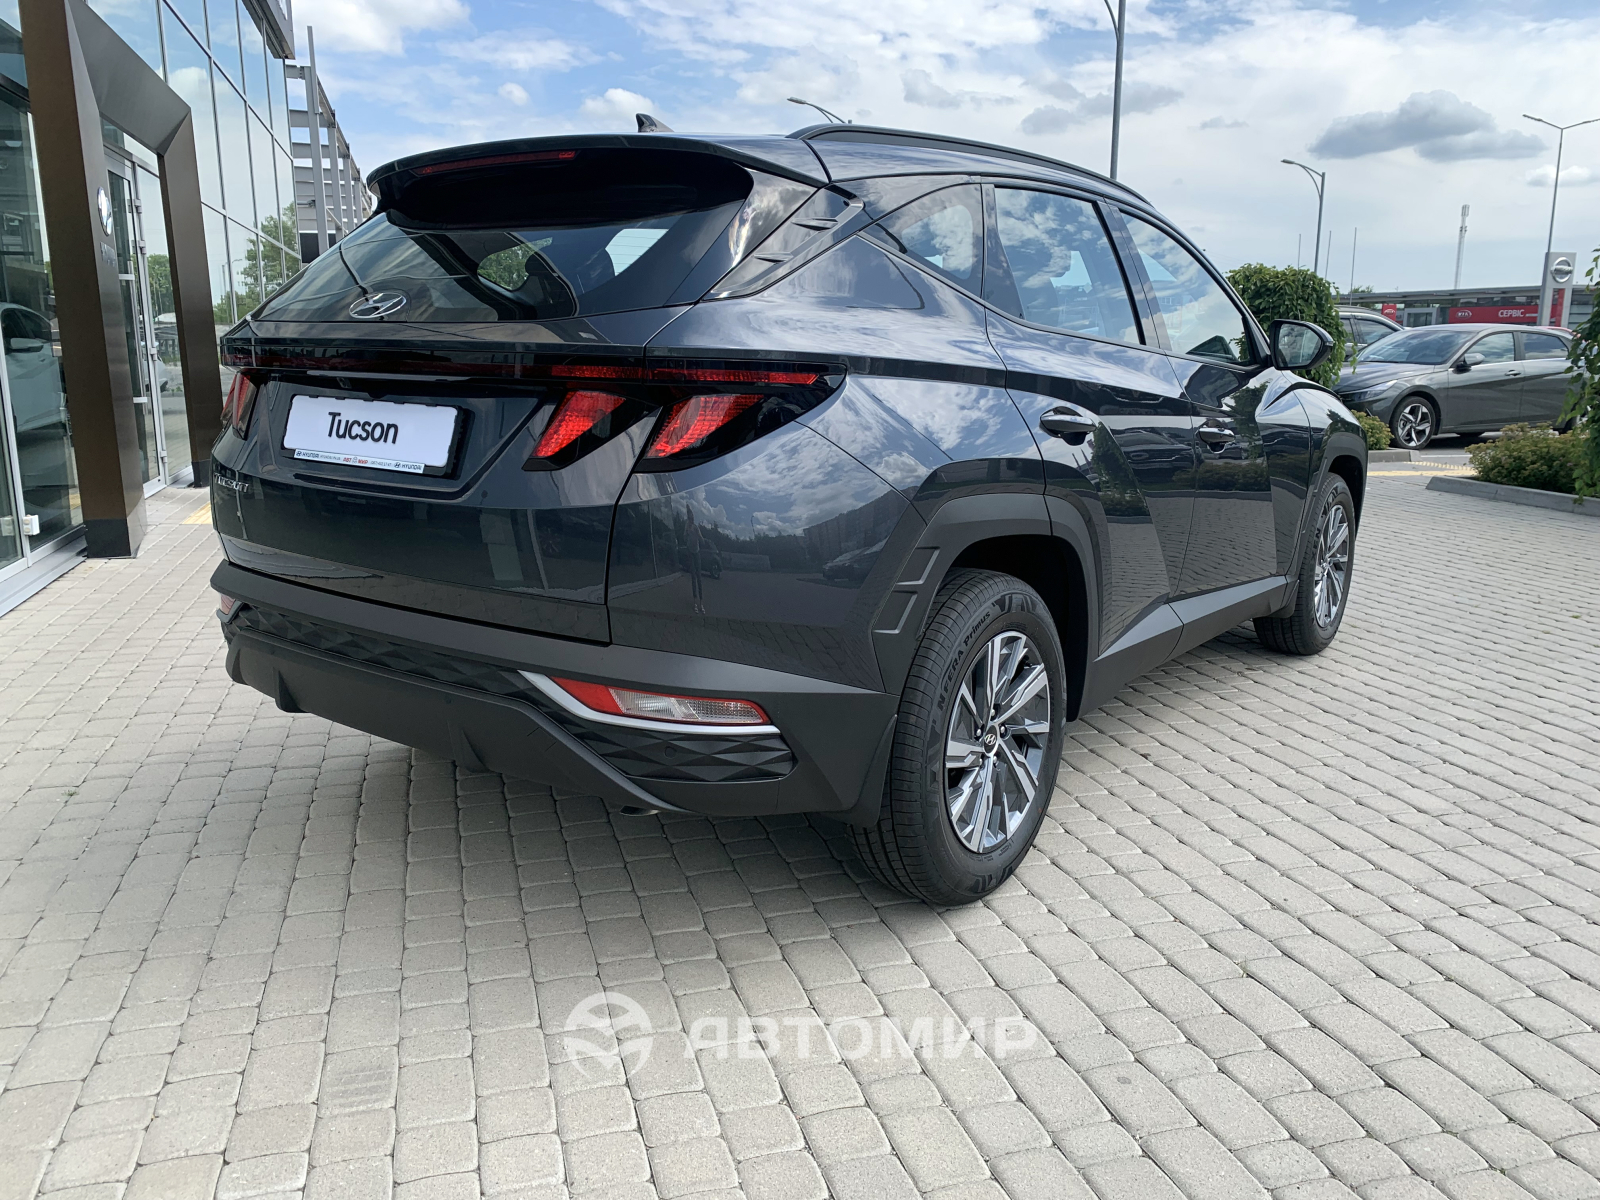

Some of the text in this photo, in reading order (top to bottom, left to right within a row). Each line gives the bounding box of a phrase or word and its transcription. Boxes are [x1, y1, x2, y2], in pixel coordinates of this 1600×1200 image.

[1498, 309, 1525, 318] СЕРВІС
[328, 411, 399, 444] Tucson
[944, 650, 964, 694] FERA
[963, 611, 991, 647] Primus
